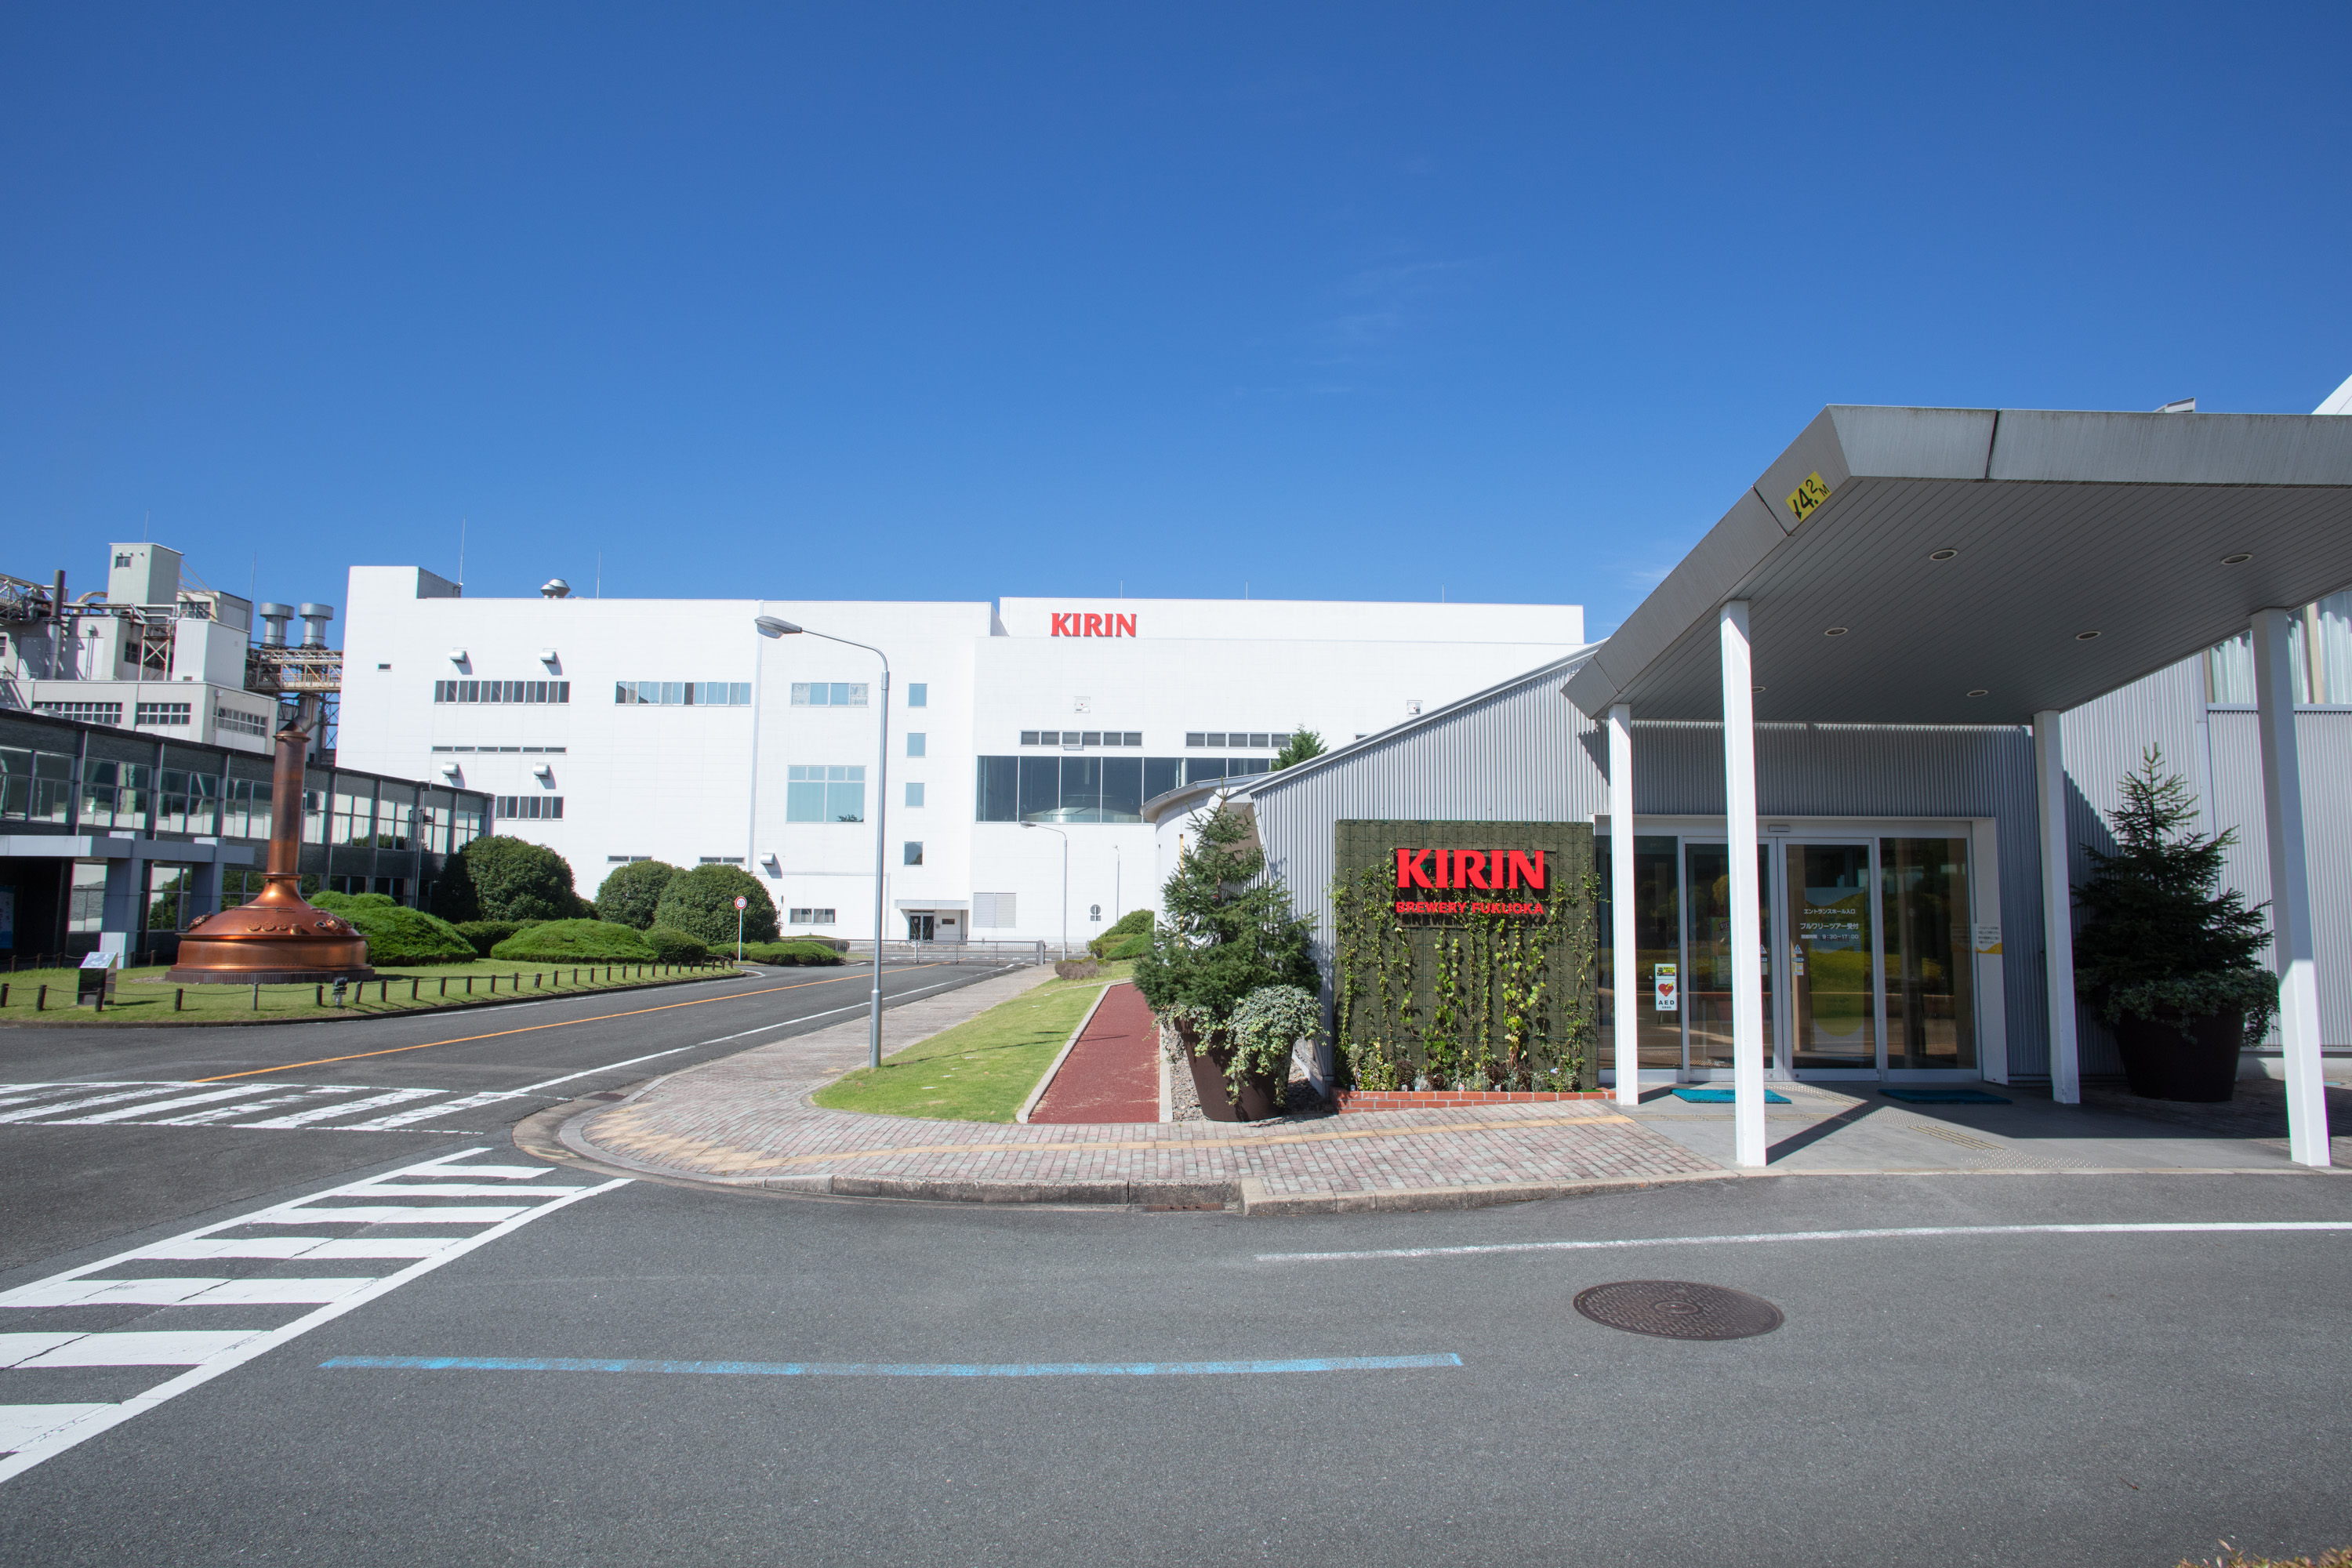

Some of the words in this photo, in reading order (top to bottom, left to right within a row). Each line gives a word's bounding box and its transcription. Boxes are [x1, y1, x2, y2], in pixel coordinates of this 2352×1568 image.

[1051, 613, 1137, 637] KIRIN
[1397, 849, 1544, 889] KIRIN
[1396, 902, 1466, 913] BREWERY
[1472, 902, 1544, 914] FUKUOKA
